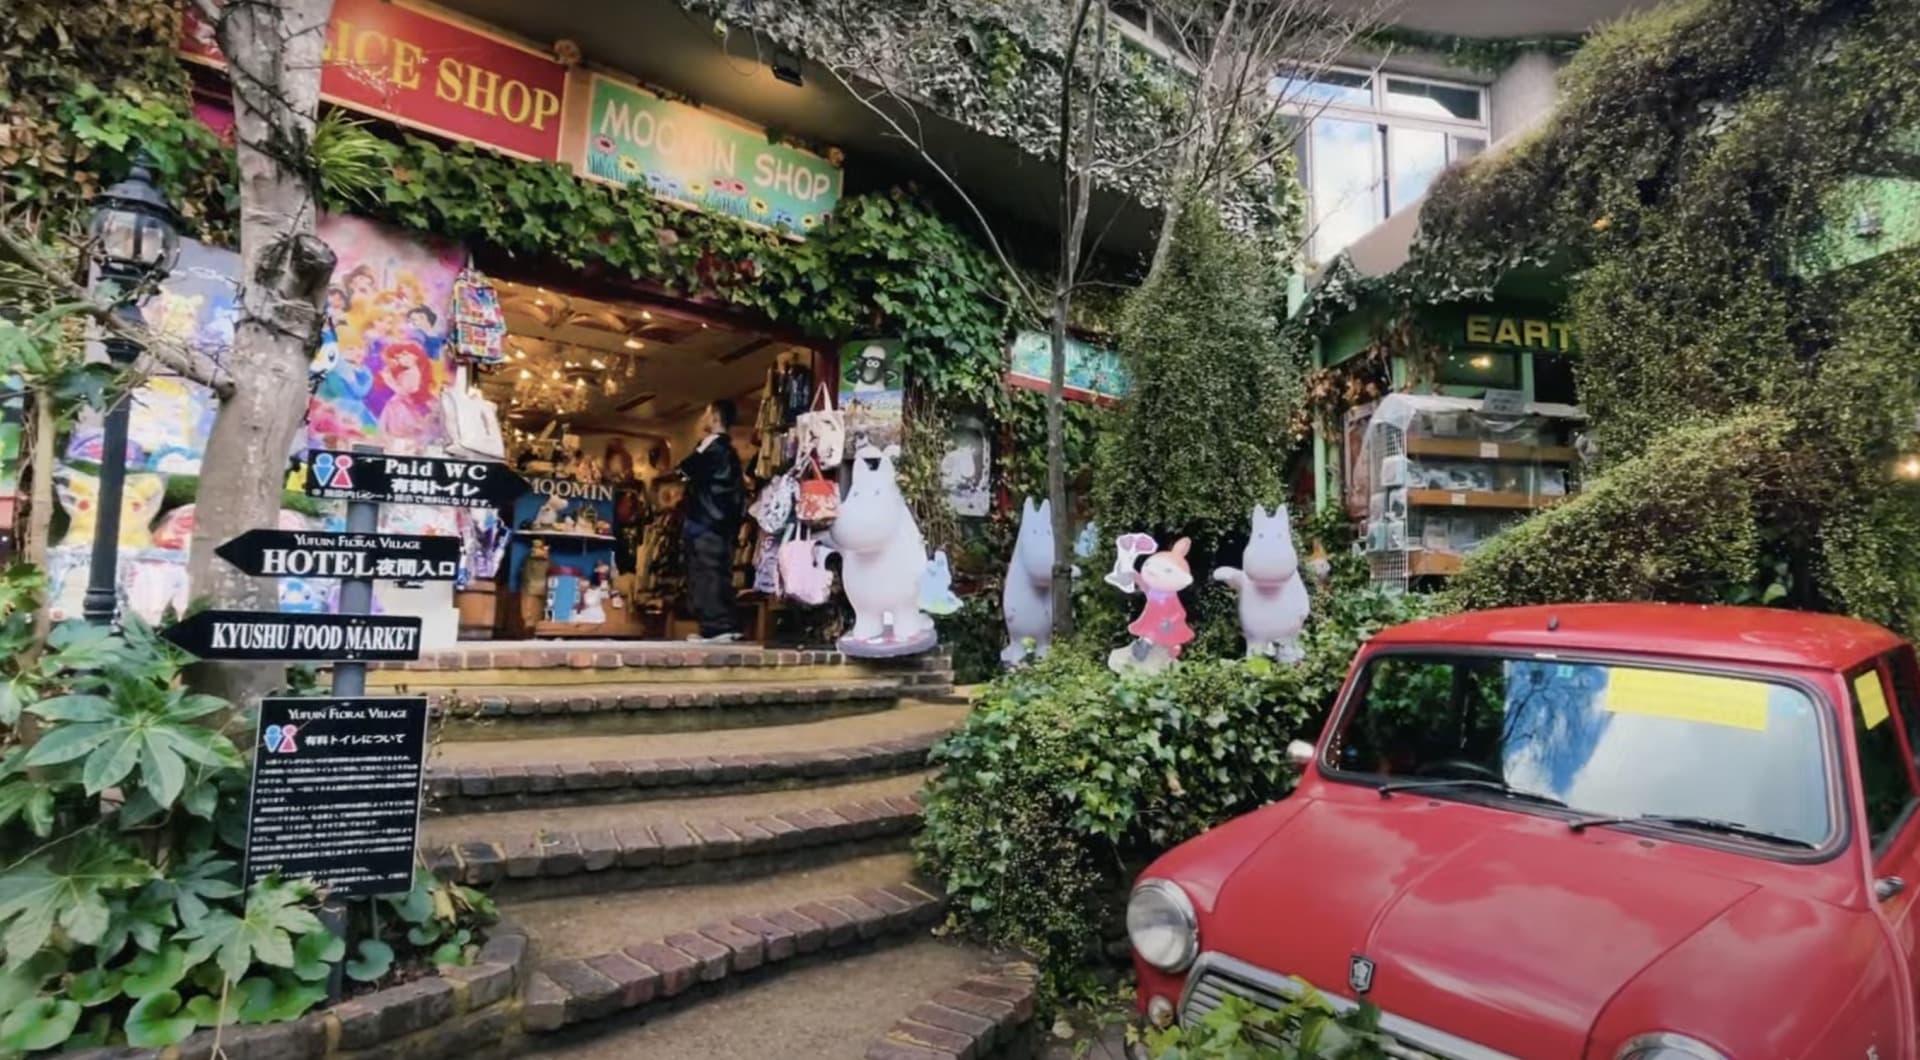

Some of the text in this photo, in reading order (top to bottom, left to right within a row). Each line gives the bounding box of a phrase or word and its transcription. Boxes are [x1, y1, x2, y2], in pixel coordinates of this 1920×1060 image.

[322, 19, 560, 131] ICE SHOP
[753, 152, 831, 203] SHOP
[384, 458, 488, 481] Paid WC
[391, 478, 481, 497] 有料トイレ
[379, 537, 421, 550] VILLAGE
[261, 548, 456, 577] HOTEL 夜間入口
[211, 622, 418, 651] KYUSHU FOOD MARKET
[368, 707, 408, 719] VILLAGE
[304, 733, 407, 747] 有料トイレについて
